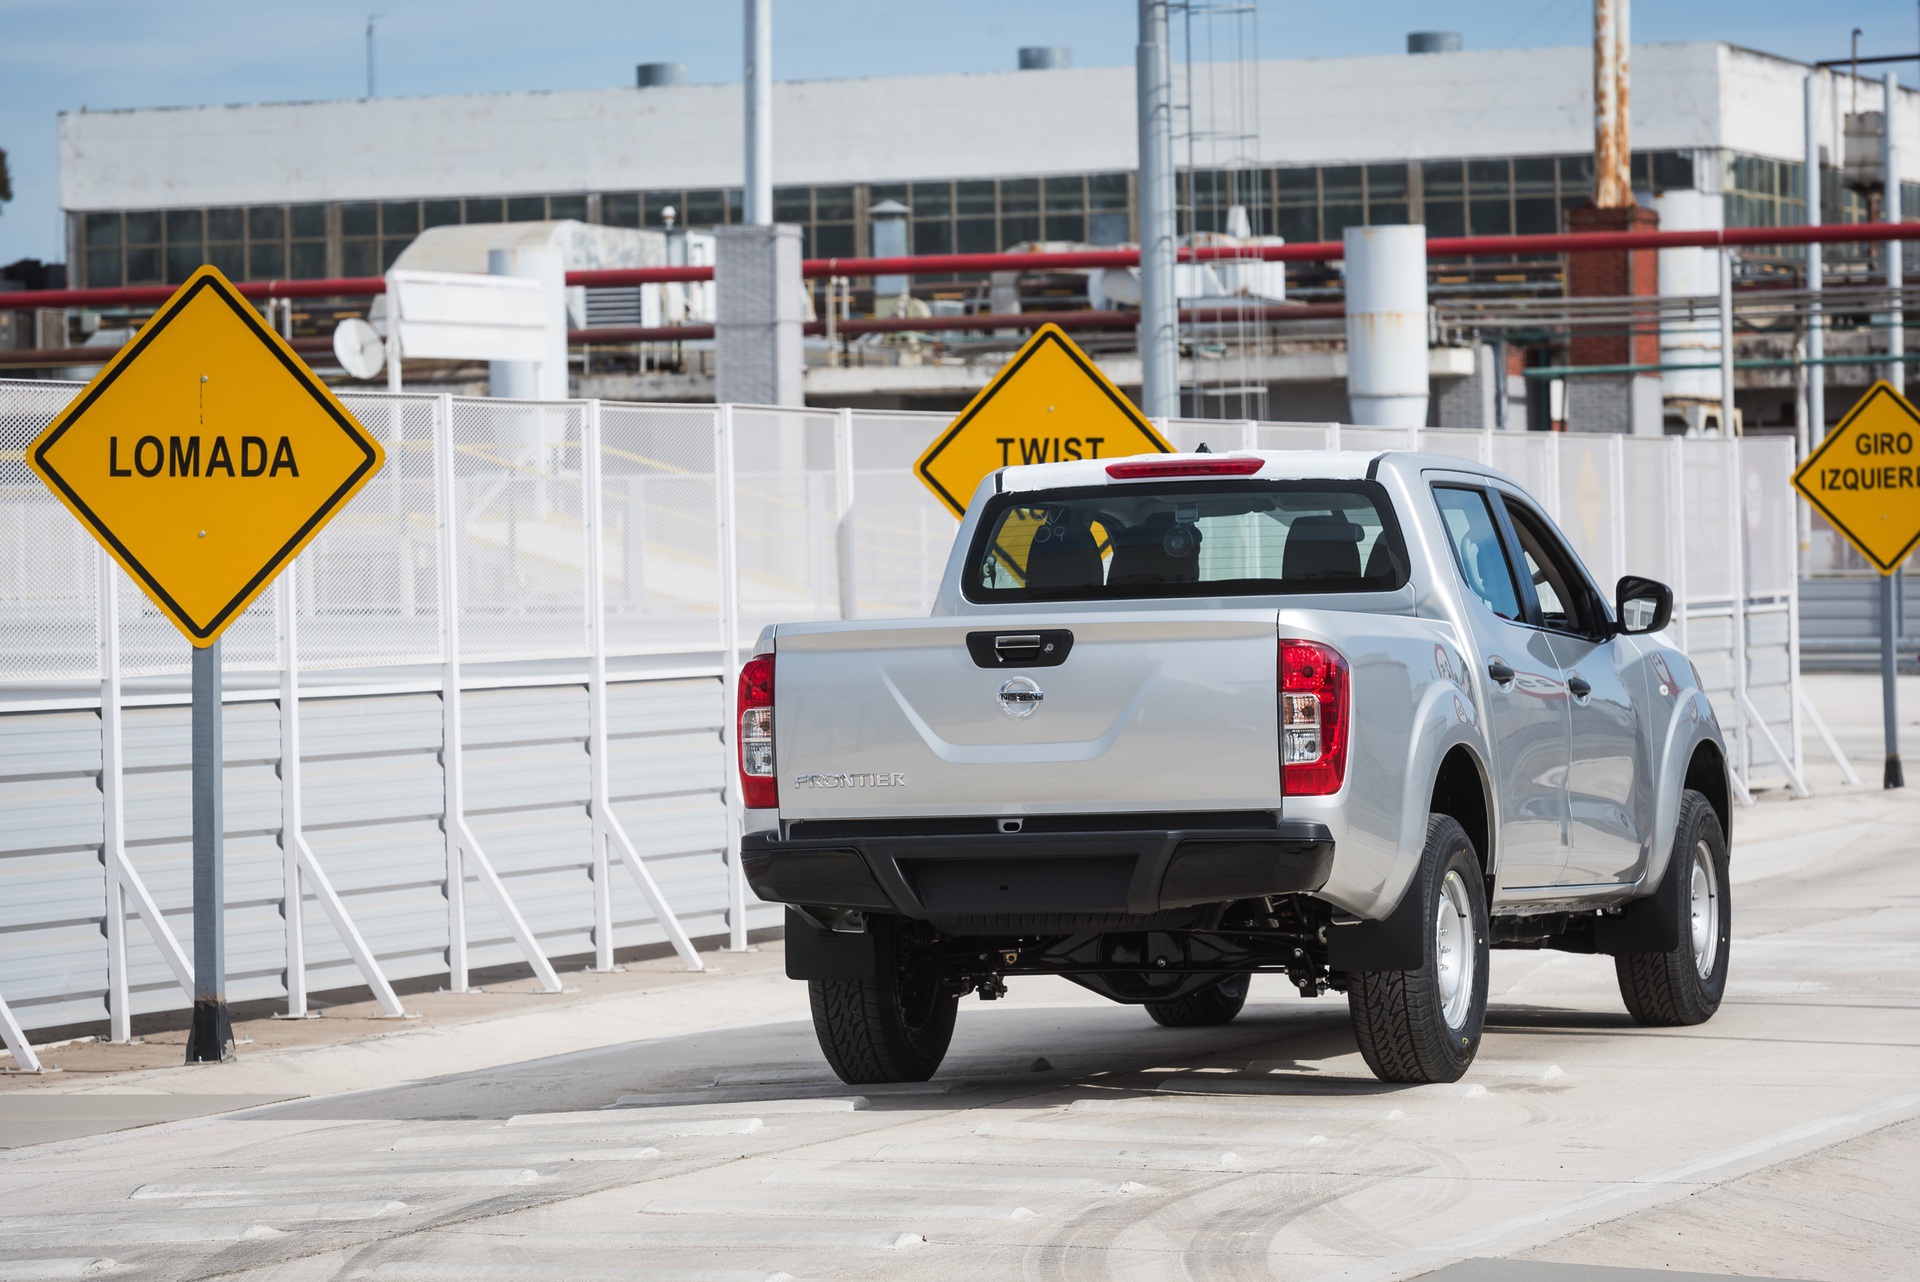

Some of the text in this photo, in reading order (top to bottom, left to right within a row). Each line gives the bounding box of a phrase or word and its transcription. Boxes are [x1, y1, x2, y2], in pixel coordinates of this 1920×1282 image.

[996, 437, 1104, 466] TWIST
[1856, 432, 1913, 455] GIRO
[109, 435, 300, 478] LOMADA
[1821, 466, 1920, 491] IZQUIER
[1000, 693, 1037, 701] NISSAN
[795, 773, 906, 789] FRONTIER
